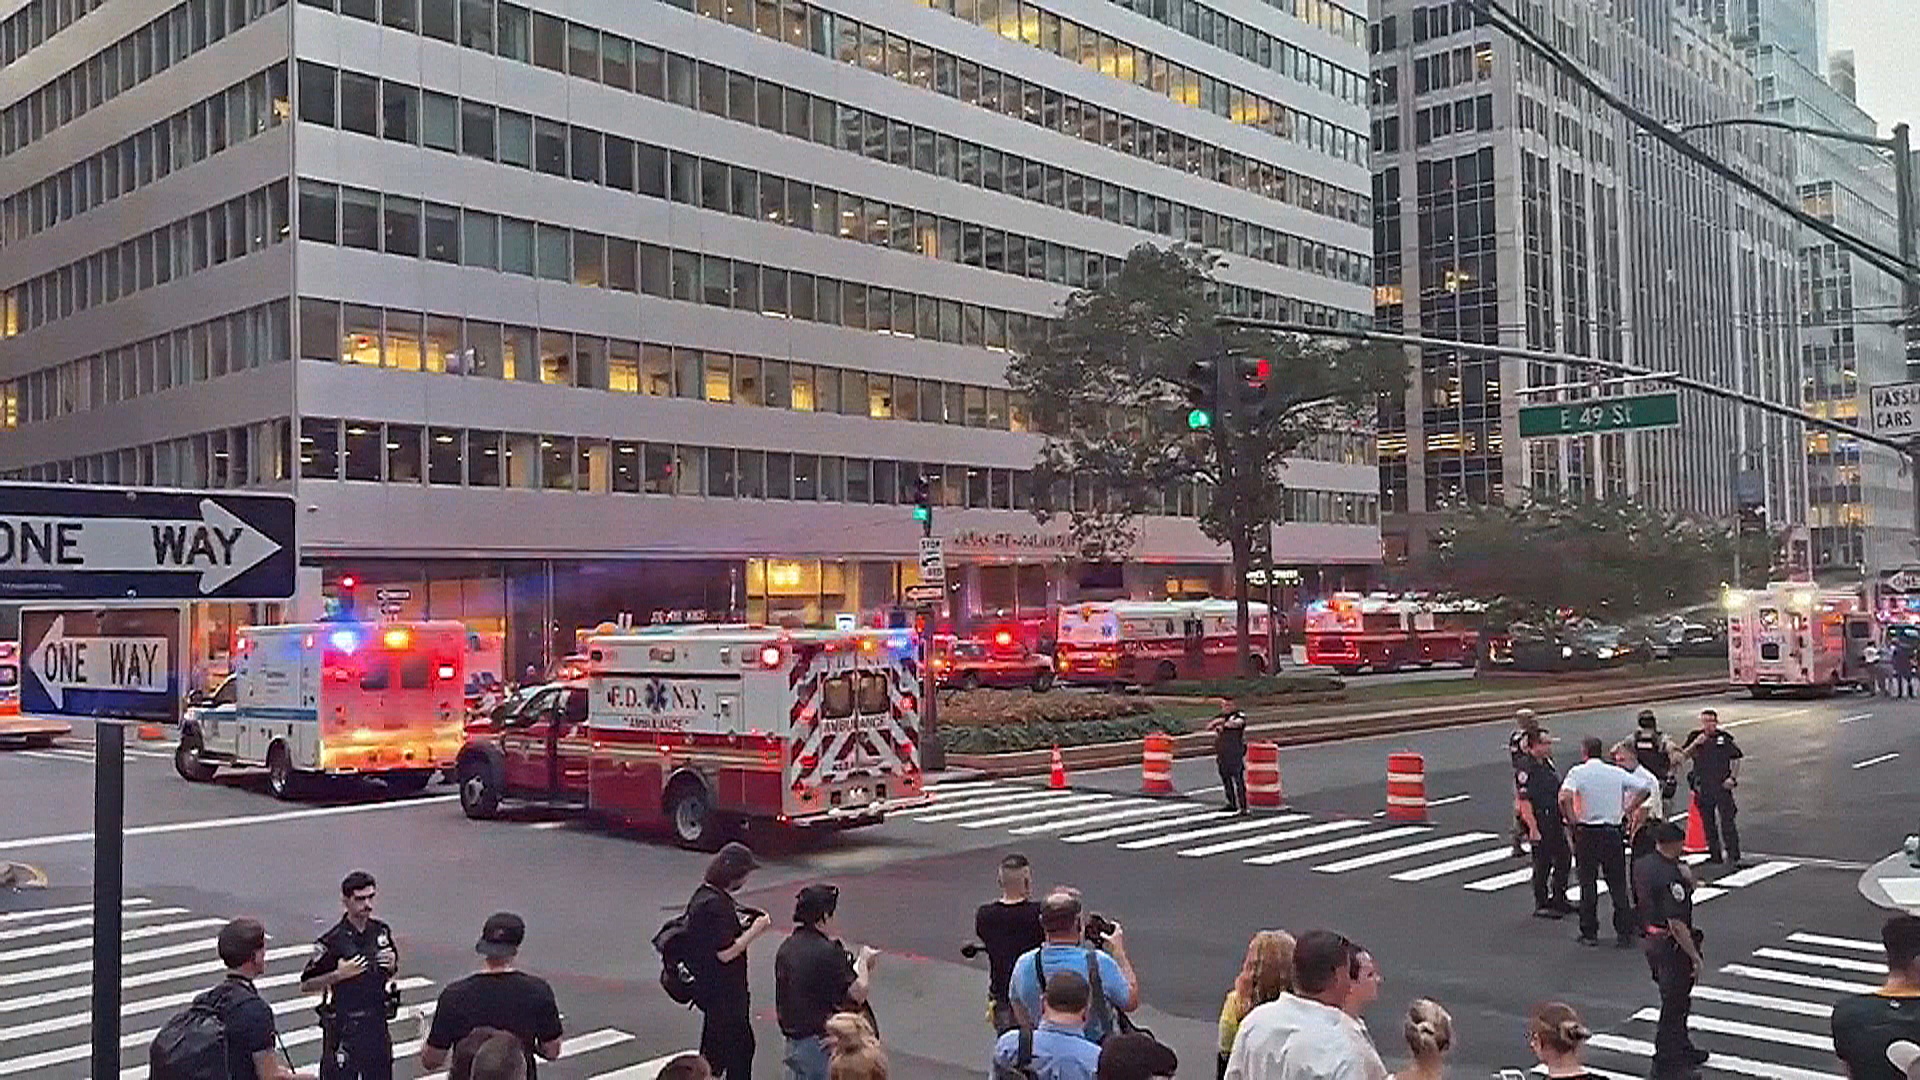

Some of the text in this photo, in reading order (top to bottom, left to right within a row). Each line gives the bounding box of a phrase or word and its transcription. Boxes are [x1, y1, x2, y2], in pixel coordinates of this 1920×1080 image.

[1561, 410, 1571, 429] E
[1579, 406, 1603, 426] 49
[1877, 410, 1912, 428] CARS
[151, 525, 243, 565] WAY
[45, 642, 158, 685] ONE WAY
[822, 716, 888, 733] AMBUANCE
